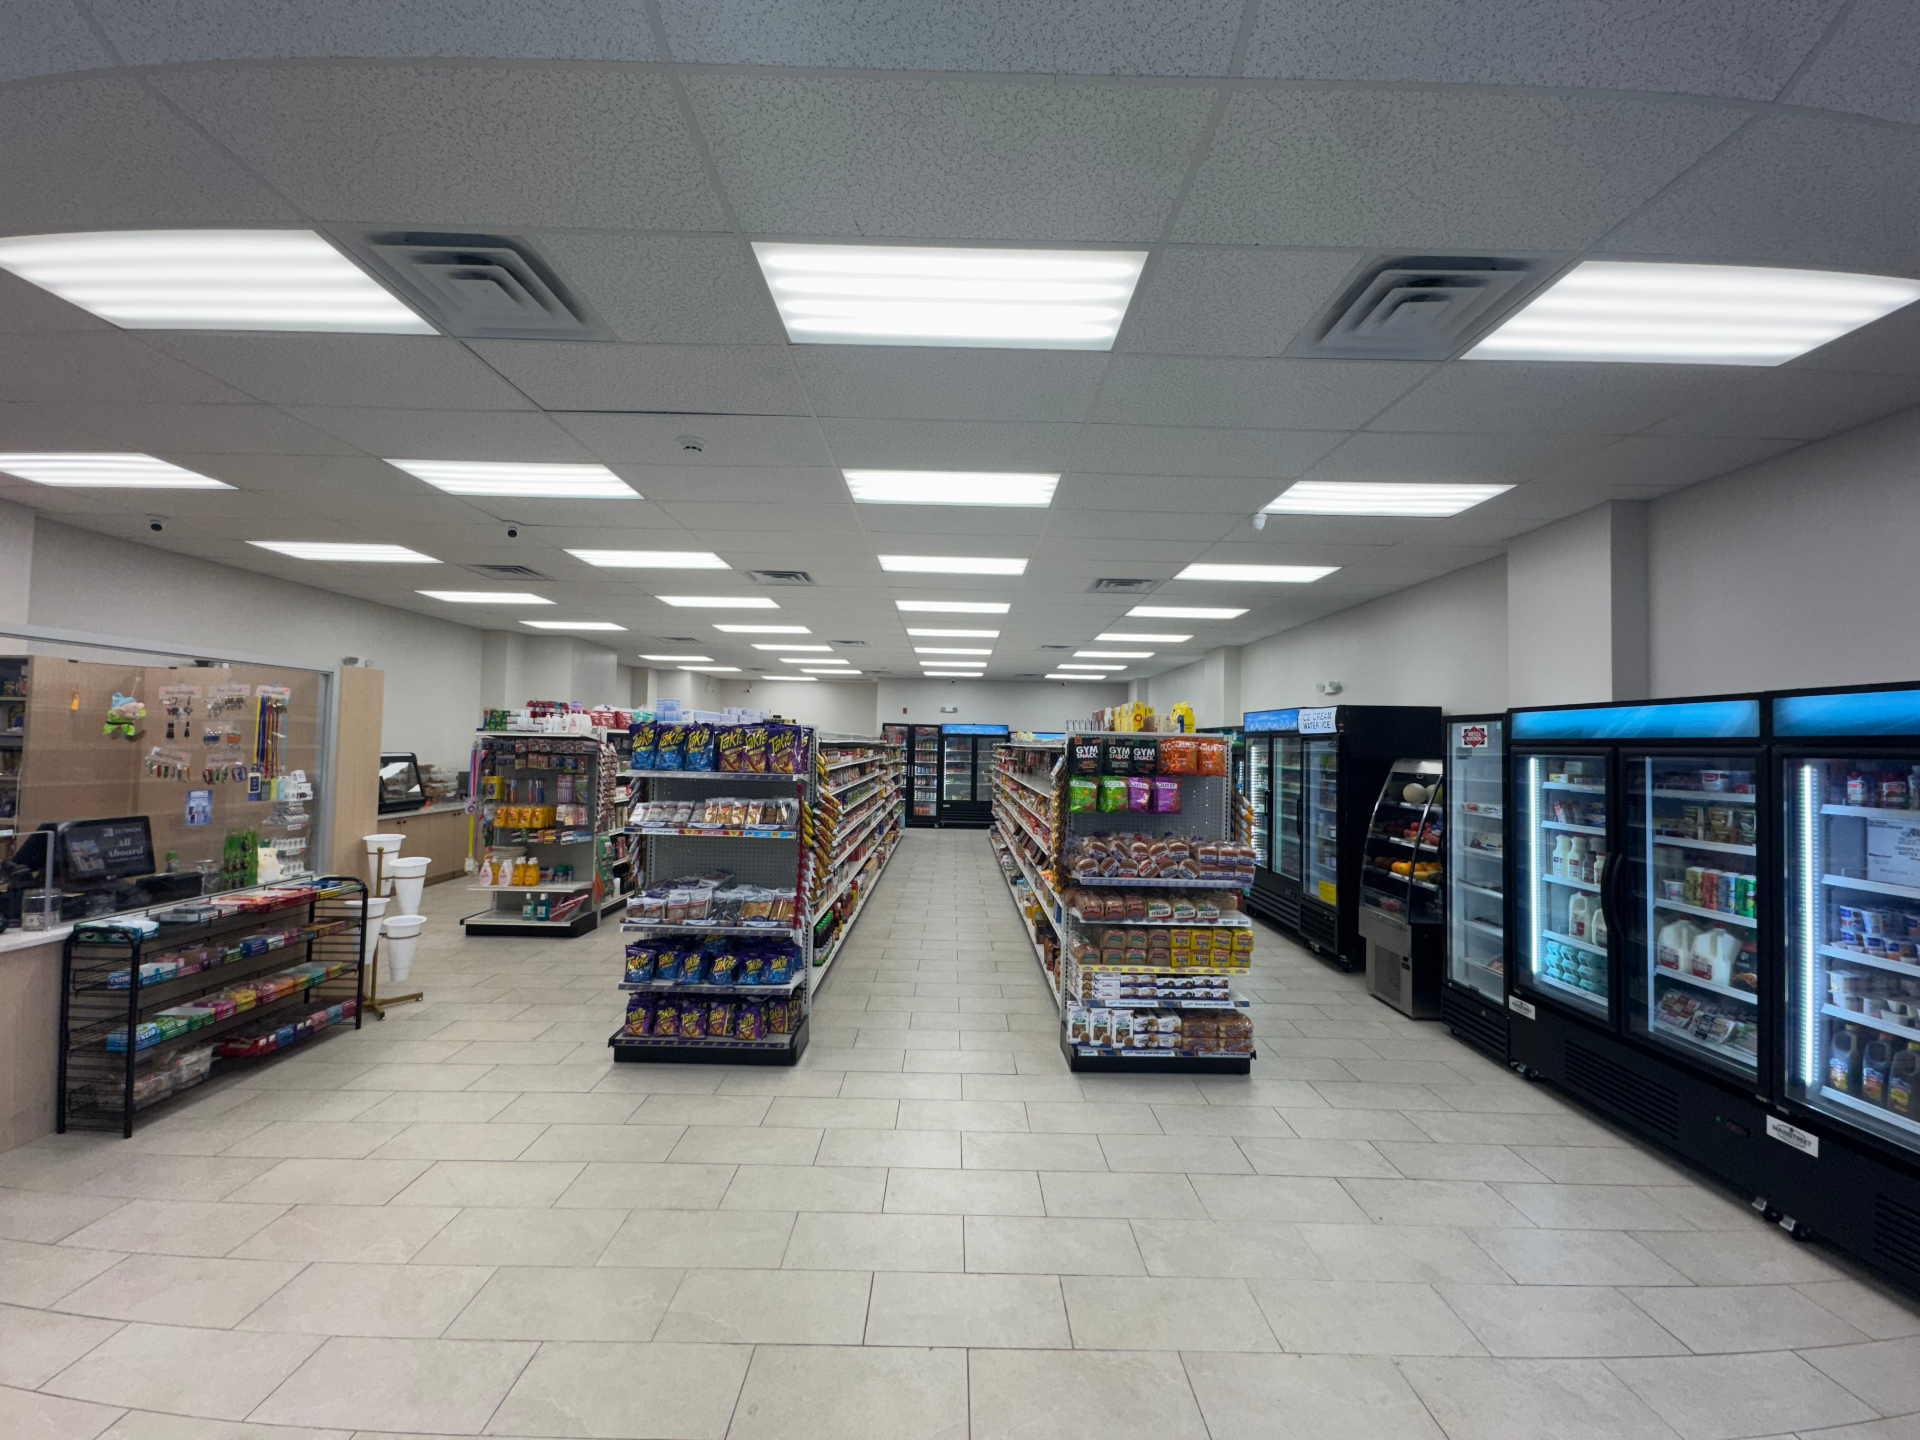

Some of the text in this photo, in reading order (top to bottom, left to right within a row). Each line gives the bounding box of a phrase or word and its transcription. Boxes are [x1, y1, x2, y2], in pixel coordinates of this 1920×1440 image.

[1302, 712, 1333, 722] ICE CREAM
[1303, 721, 1331, 730] WATER ICE
[744, 731, 768, 753] Takis
[769, 734, 796, 756] Takis
[1075, 745, 1099, 754] GYM
[1109, 746, 1131, 755] GYM
[1133, 747, 1156, 756] GYM
[118, 837, 132, 847] All
[107, 846, 144, 859] Aboard
[1215, 937, 1230, 945] Small
[1772, 1124, 1812, 1148] MAINSTREET
